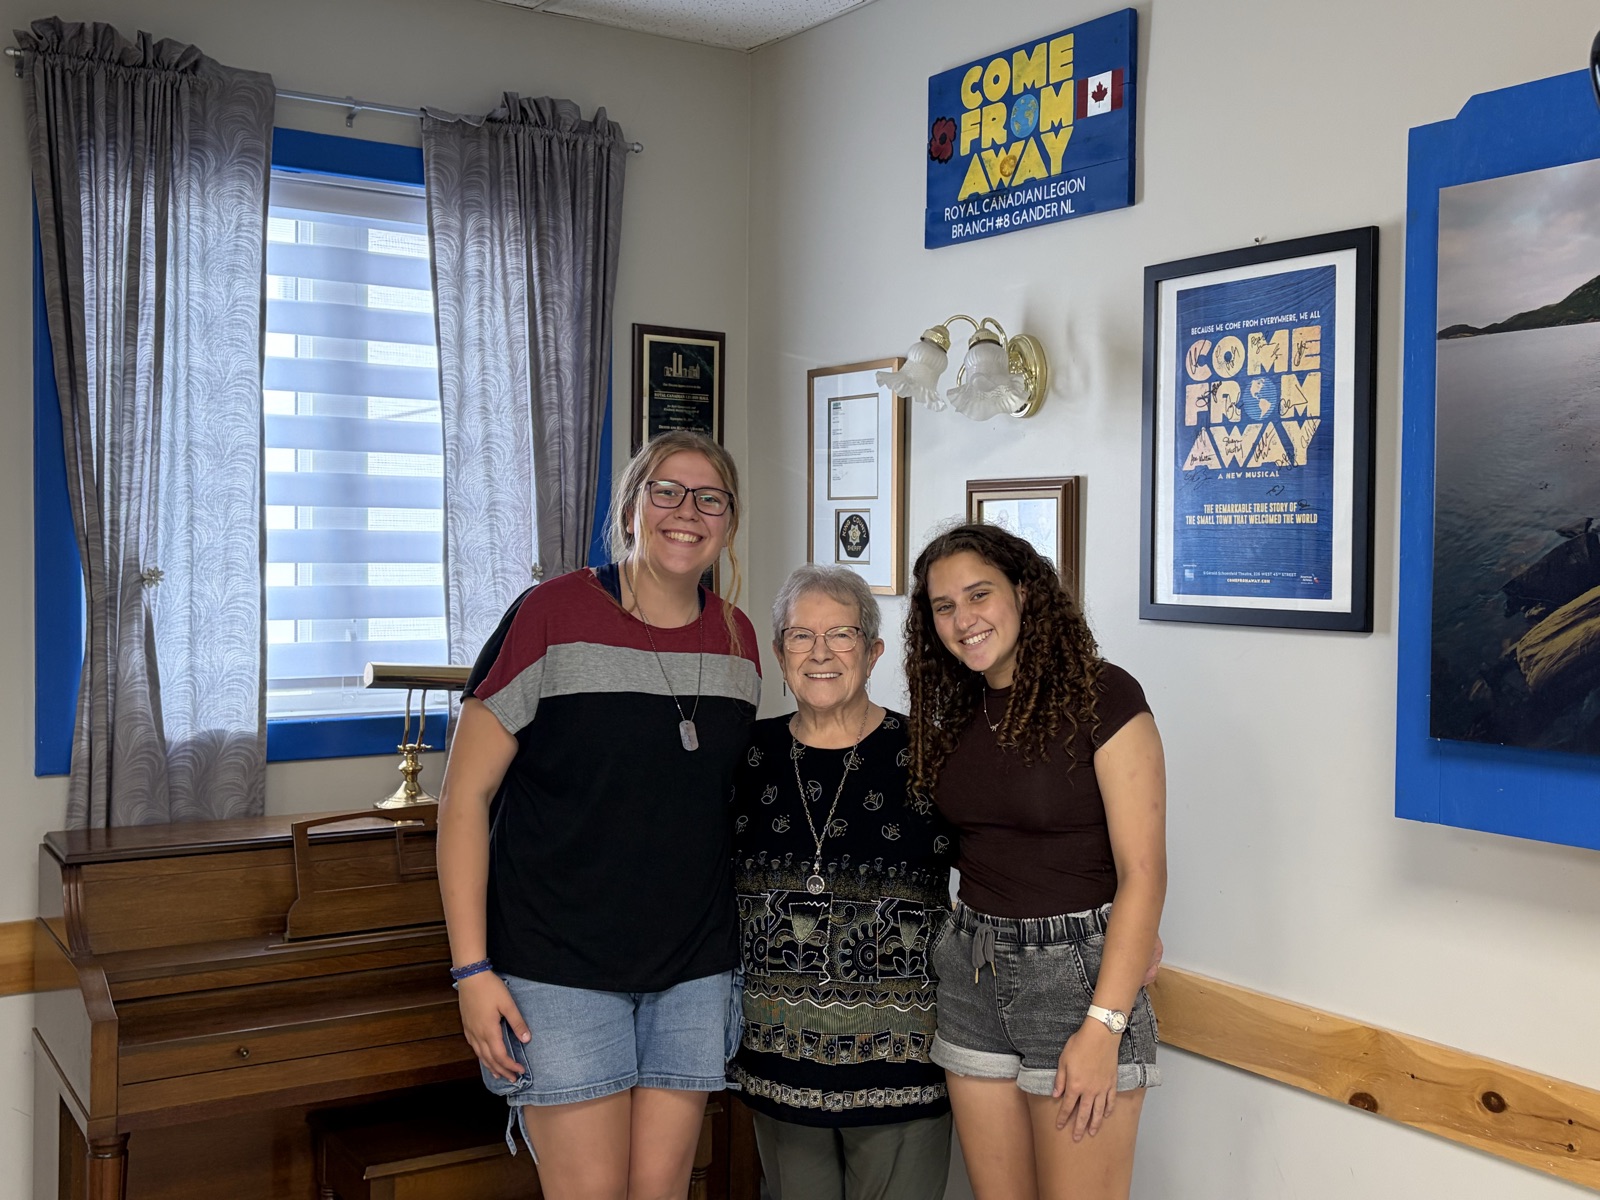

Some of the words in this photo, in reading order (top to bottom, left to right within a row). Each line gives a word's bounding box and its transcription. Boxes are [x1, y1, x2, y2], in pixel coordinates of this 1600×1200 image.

[961, 33, 1074, 109] COME
[958, 126, 1074, 201] AWAY
[944, 202, 980, 221] ROYAL
[982, 186, 1042, 212] CANADIAN
[1044, 176, 1086, 200] LEGION
[952, 218, 994, 239] BRANCH
[995, 214, 1010, 229] #8
[1012, 202, 1058, 226] GANDER
[1060, 199, 1075, 215] NL
[1191, 324, 1214, 335] BECAUSE
[1215, 323, 1224, 332] WE
[1225, 321, 1241, 330] COME
[1242, 319, 1259, 328] FROM
[1260, 313, 1298, 325] EVERYWHERE,
[1299, 312, 1308, 320] WE
[1310, 311, 1321, 319] ALL
[1185, 325, 1321, 381] COME
[1182, 419, 1321, 471] AWAY
[1186, 515, 1196, 525] THE
[1196, 515, 1216, 525] SMALL
[1216, 515, 1232, 524] TOWN
[1233, 514, 1248, 524] THAT
[1248, 514, 1281, 524] WELCOMED
[1283, 513, 1294, 524] THE
[1295, 513, 1318, 523] WORLD
[1203, 504, 1214, 514] THE
[1215, 503, 1252, 513] REMARKABLE
[1253, 503, 1268, 512] TRUE
[1269, 502, 1288, 512] STORY
[1289, 502, 1298, 512] OF
